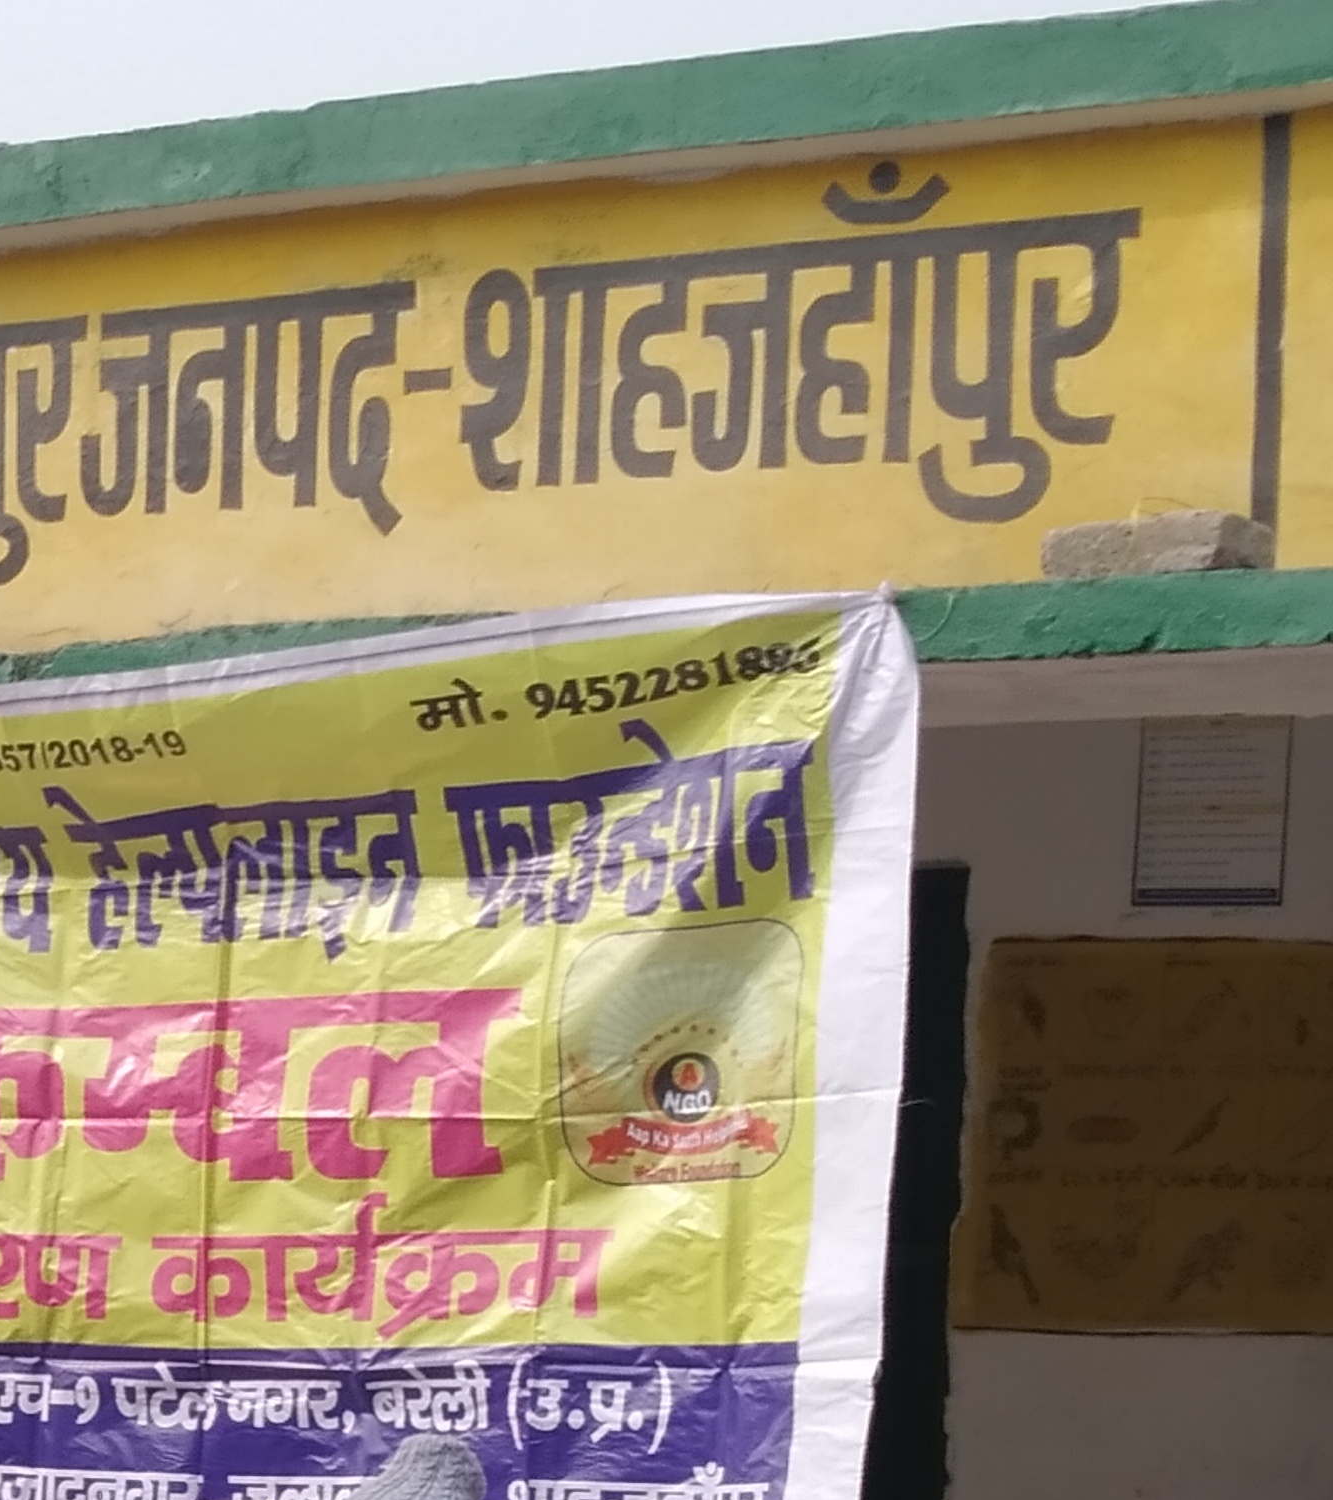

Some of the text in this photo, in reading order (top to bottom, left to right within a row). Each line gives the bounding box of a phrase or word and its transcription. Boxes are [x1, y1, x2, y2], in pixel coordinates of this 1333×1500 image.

[149, 1190, 616, 1341] कार्यक्रम
[111, 1360, 222, 1431] पटेल
[365, 1360, 491, 1434] बरेली
